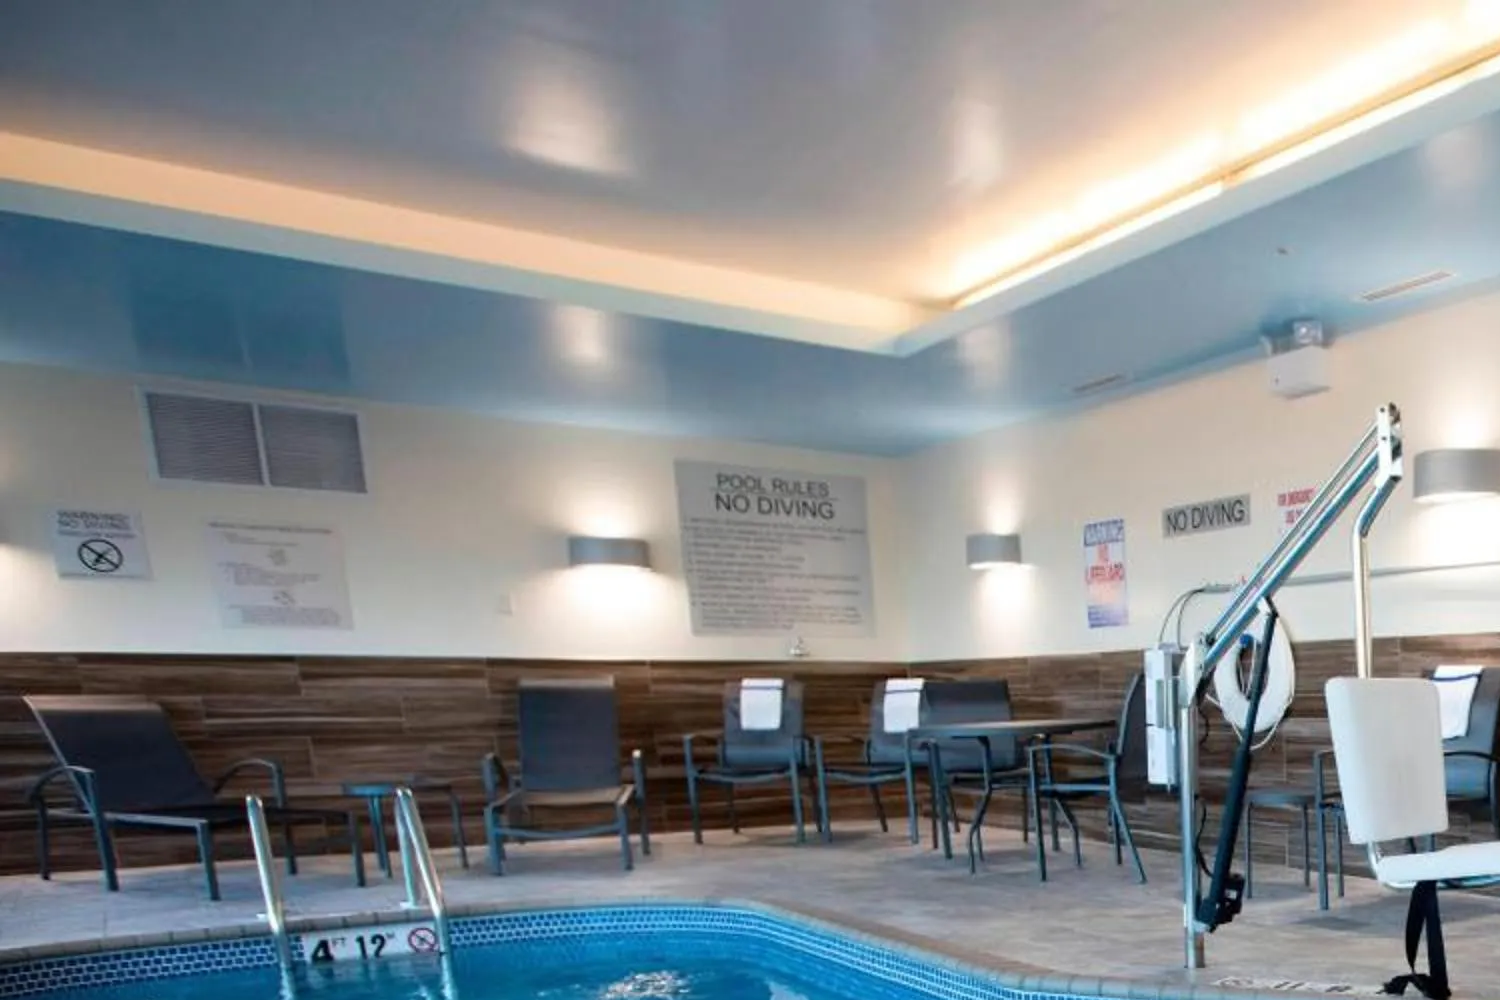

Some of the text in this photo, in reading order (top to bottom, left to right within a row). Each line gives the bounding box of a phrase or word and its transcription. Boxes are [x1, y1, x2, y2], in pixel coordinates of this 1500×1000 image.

[716, 472, 830, 498] POOL RULES
[715, 493, 835, 520] NO DIVING
[1167, 499, 1245, 533] NO DIVING
[312, 939, 334, 963] 4
